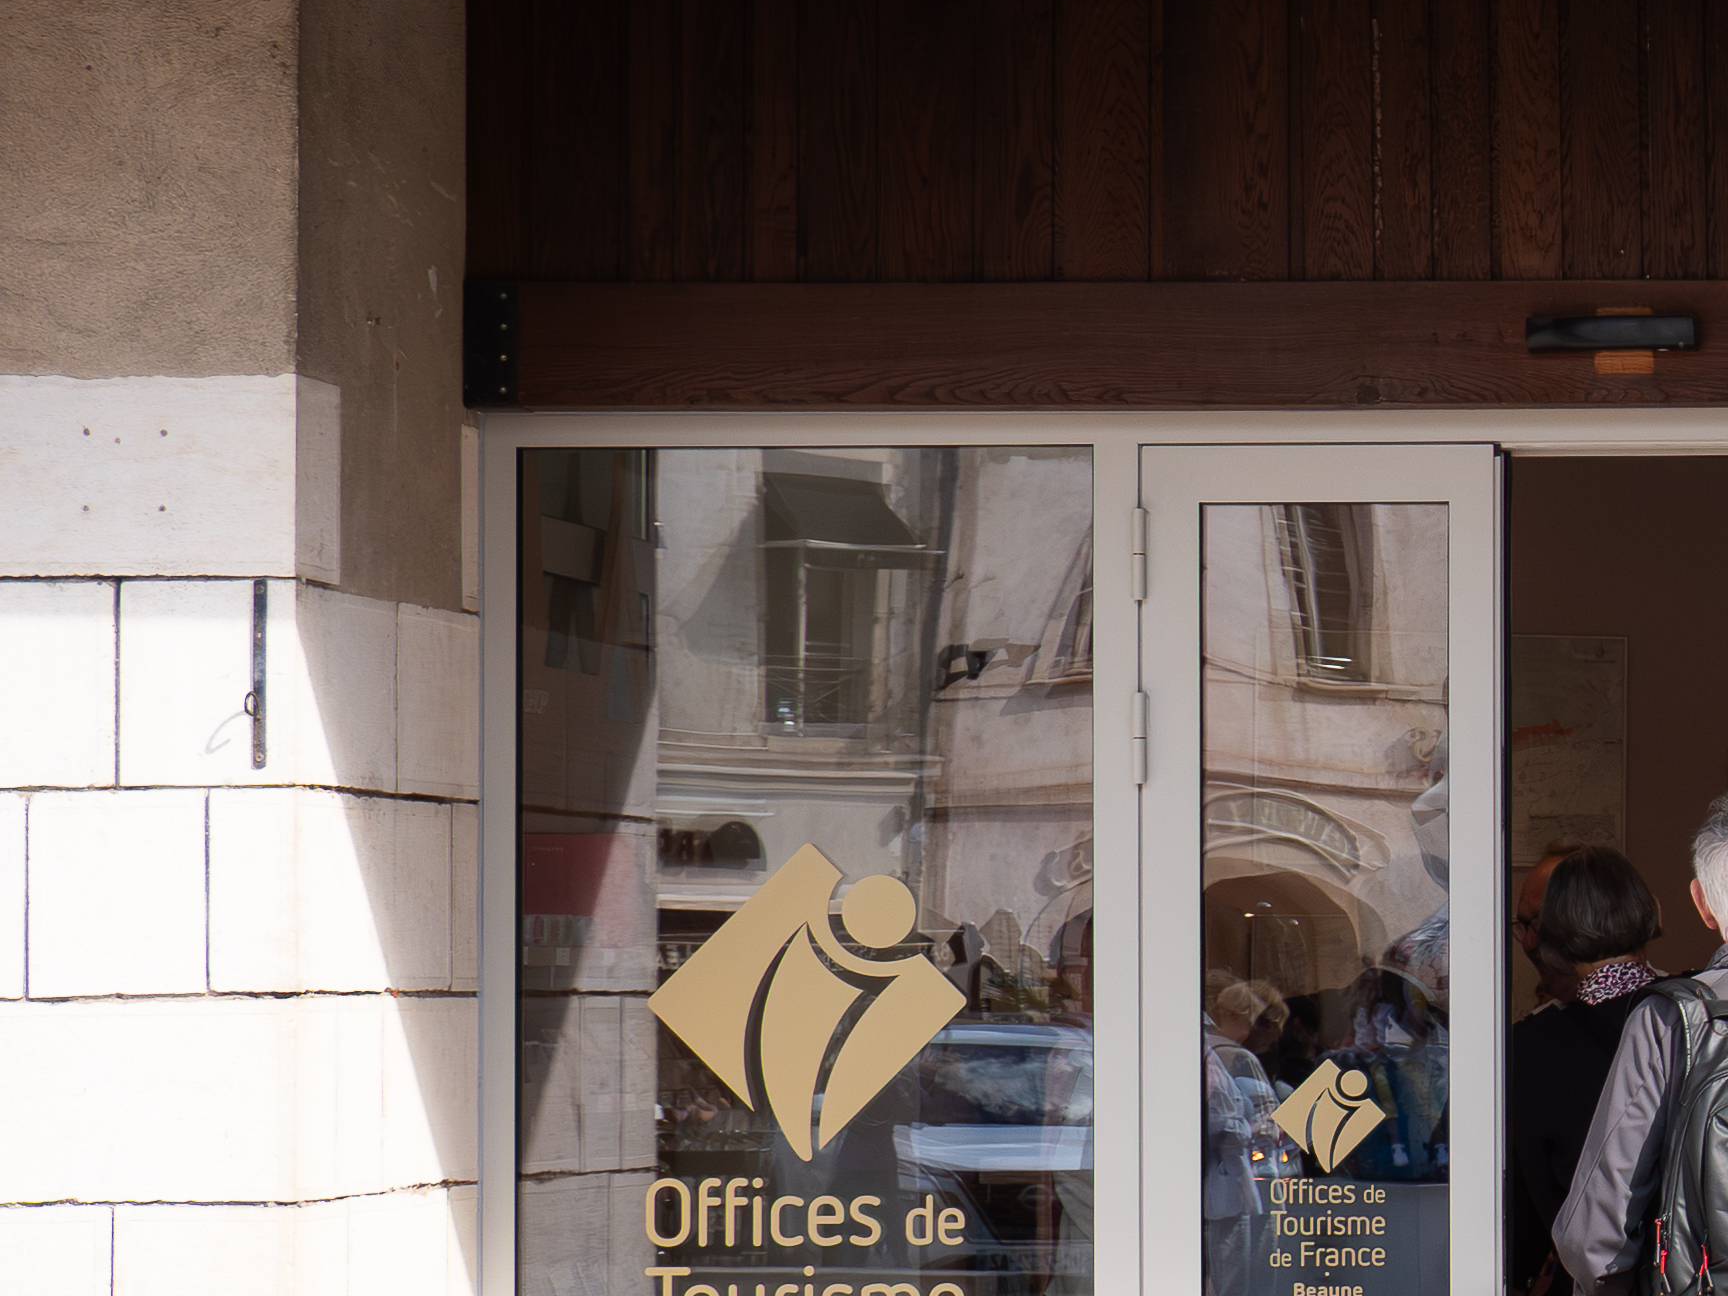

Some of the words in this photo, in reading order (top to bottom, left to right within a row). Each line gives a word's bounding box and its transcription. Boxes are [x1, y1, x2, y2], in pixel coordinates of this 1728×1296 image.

[1269, 1178, 1356, 1205] Offices
[1363, 1184, 1386, 1204] de
[645, 1178, 882, 1249] Offices
[905, 1194, 966, 1248] de
[1270, 1210, 1386, 1236] Tourisme
[1269, 1249, 1292, 1268] de
[1300, 1241, 1386, 1267] France
